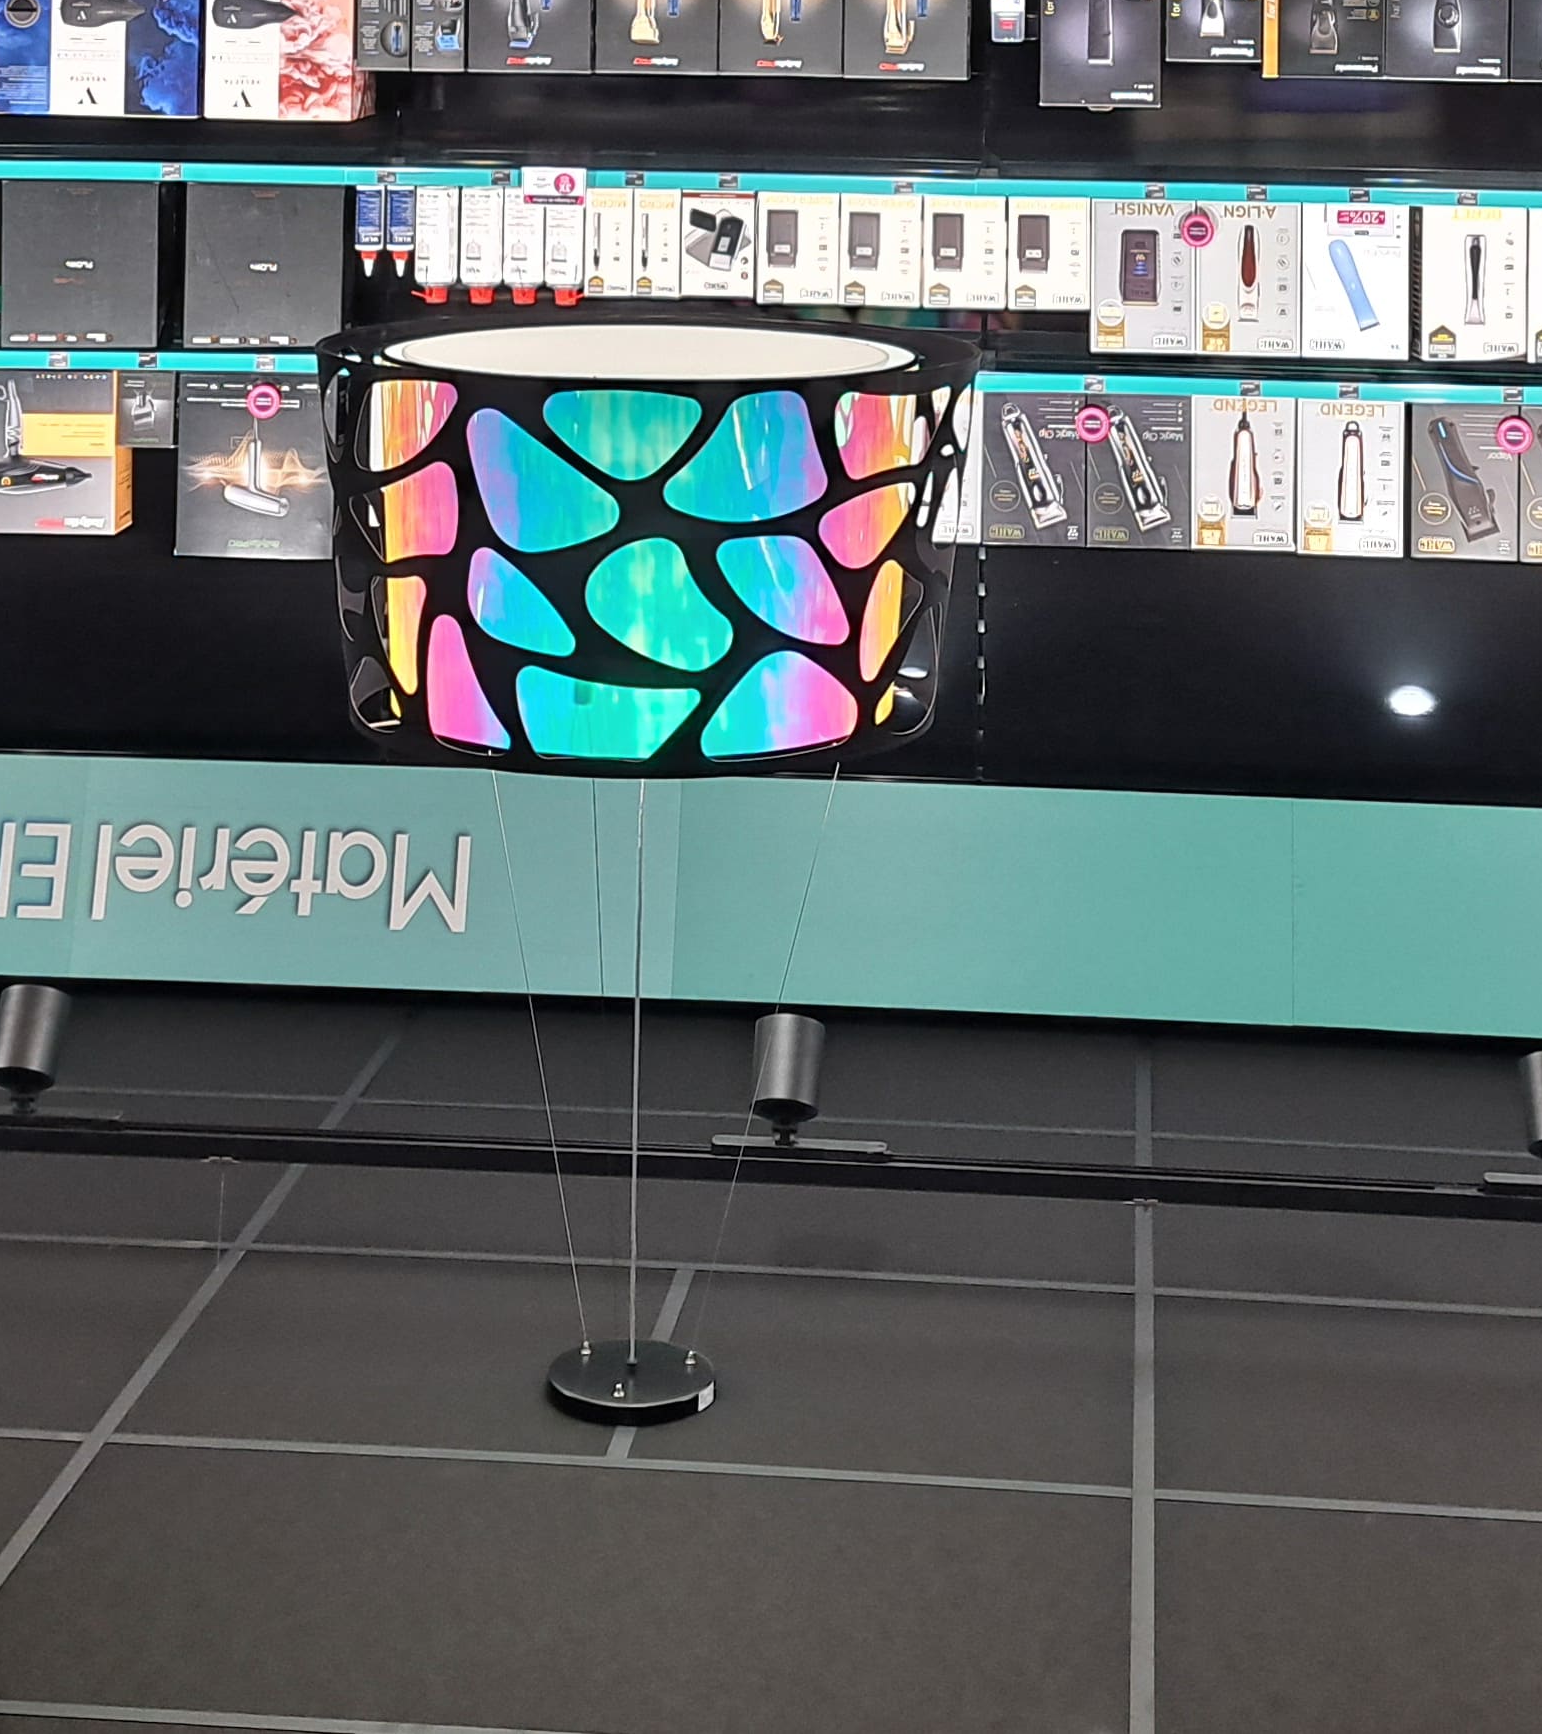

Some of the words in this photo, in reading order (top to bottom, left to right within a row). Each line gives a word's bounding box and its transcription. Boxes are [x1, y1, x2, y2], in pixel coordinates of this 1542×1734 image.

[1114, 203, 1174, 215] VANISH
[1213, 398, 1278, 411] LEGEND
[1320, 403, 1385, 417] LEGEND
[90, 822, 472, 933] Matériel
